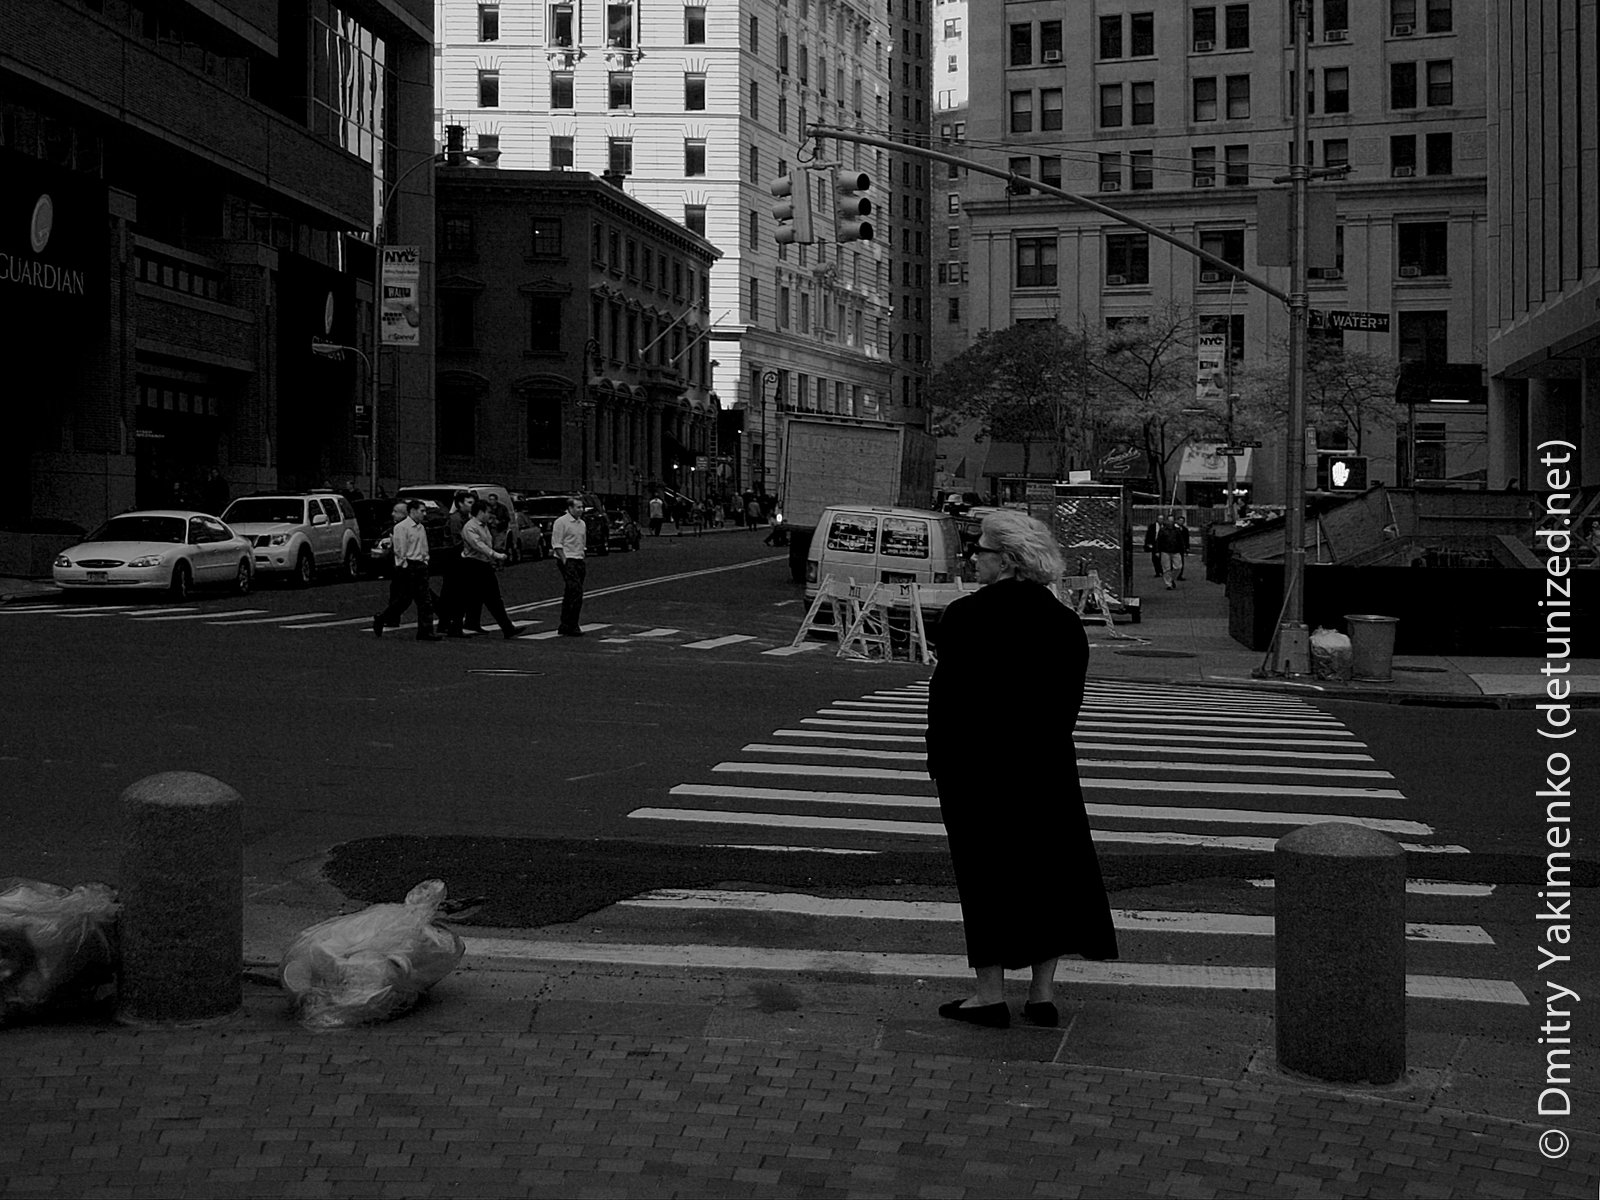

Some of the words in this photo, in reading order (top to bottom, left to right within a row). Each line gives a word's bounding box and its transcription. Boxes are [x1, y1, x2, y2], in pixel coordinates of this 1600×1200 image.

[385, 248, 417, 262] NYC
[0, 253, 84, 296] GUARDIAN
[1333, 314, 1377, 329] WATER
[1200, 337, 1223, 345] NYC
